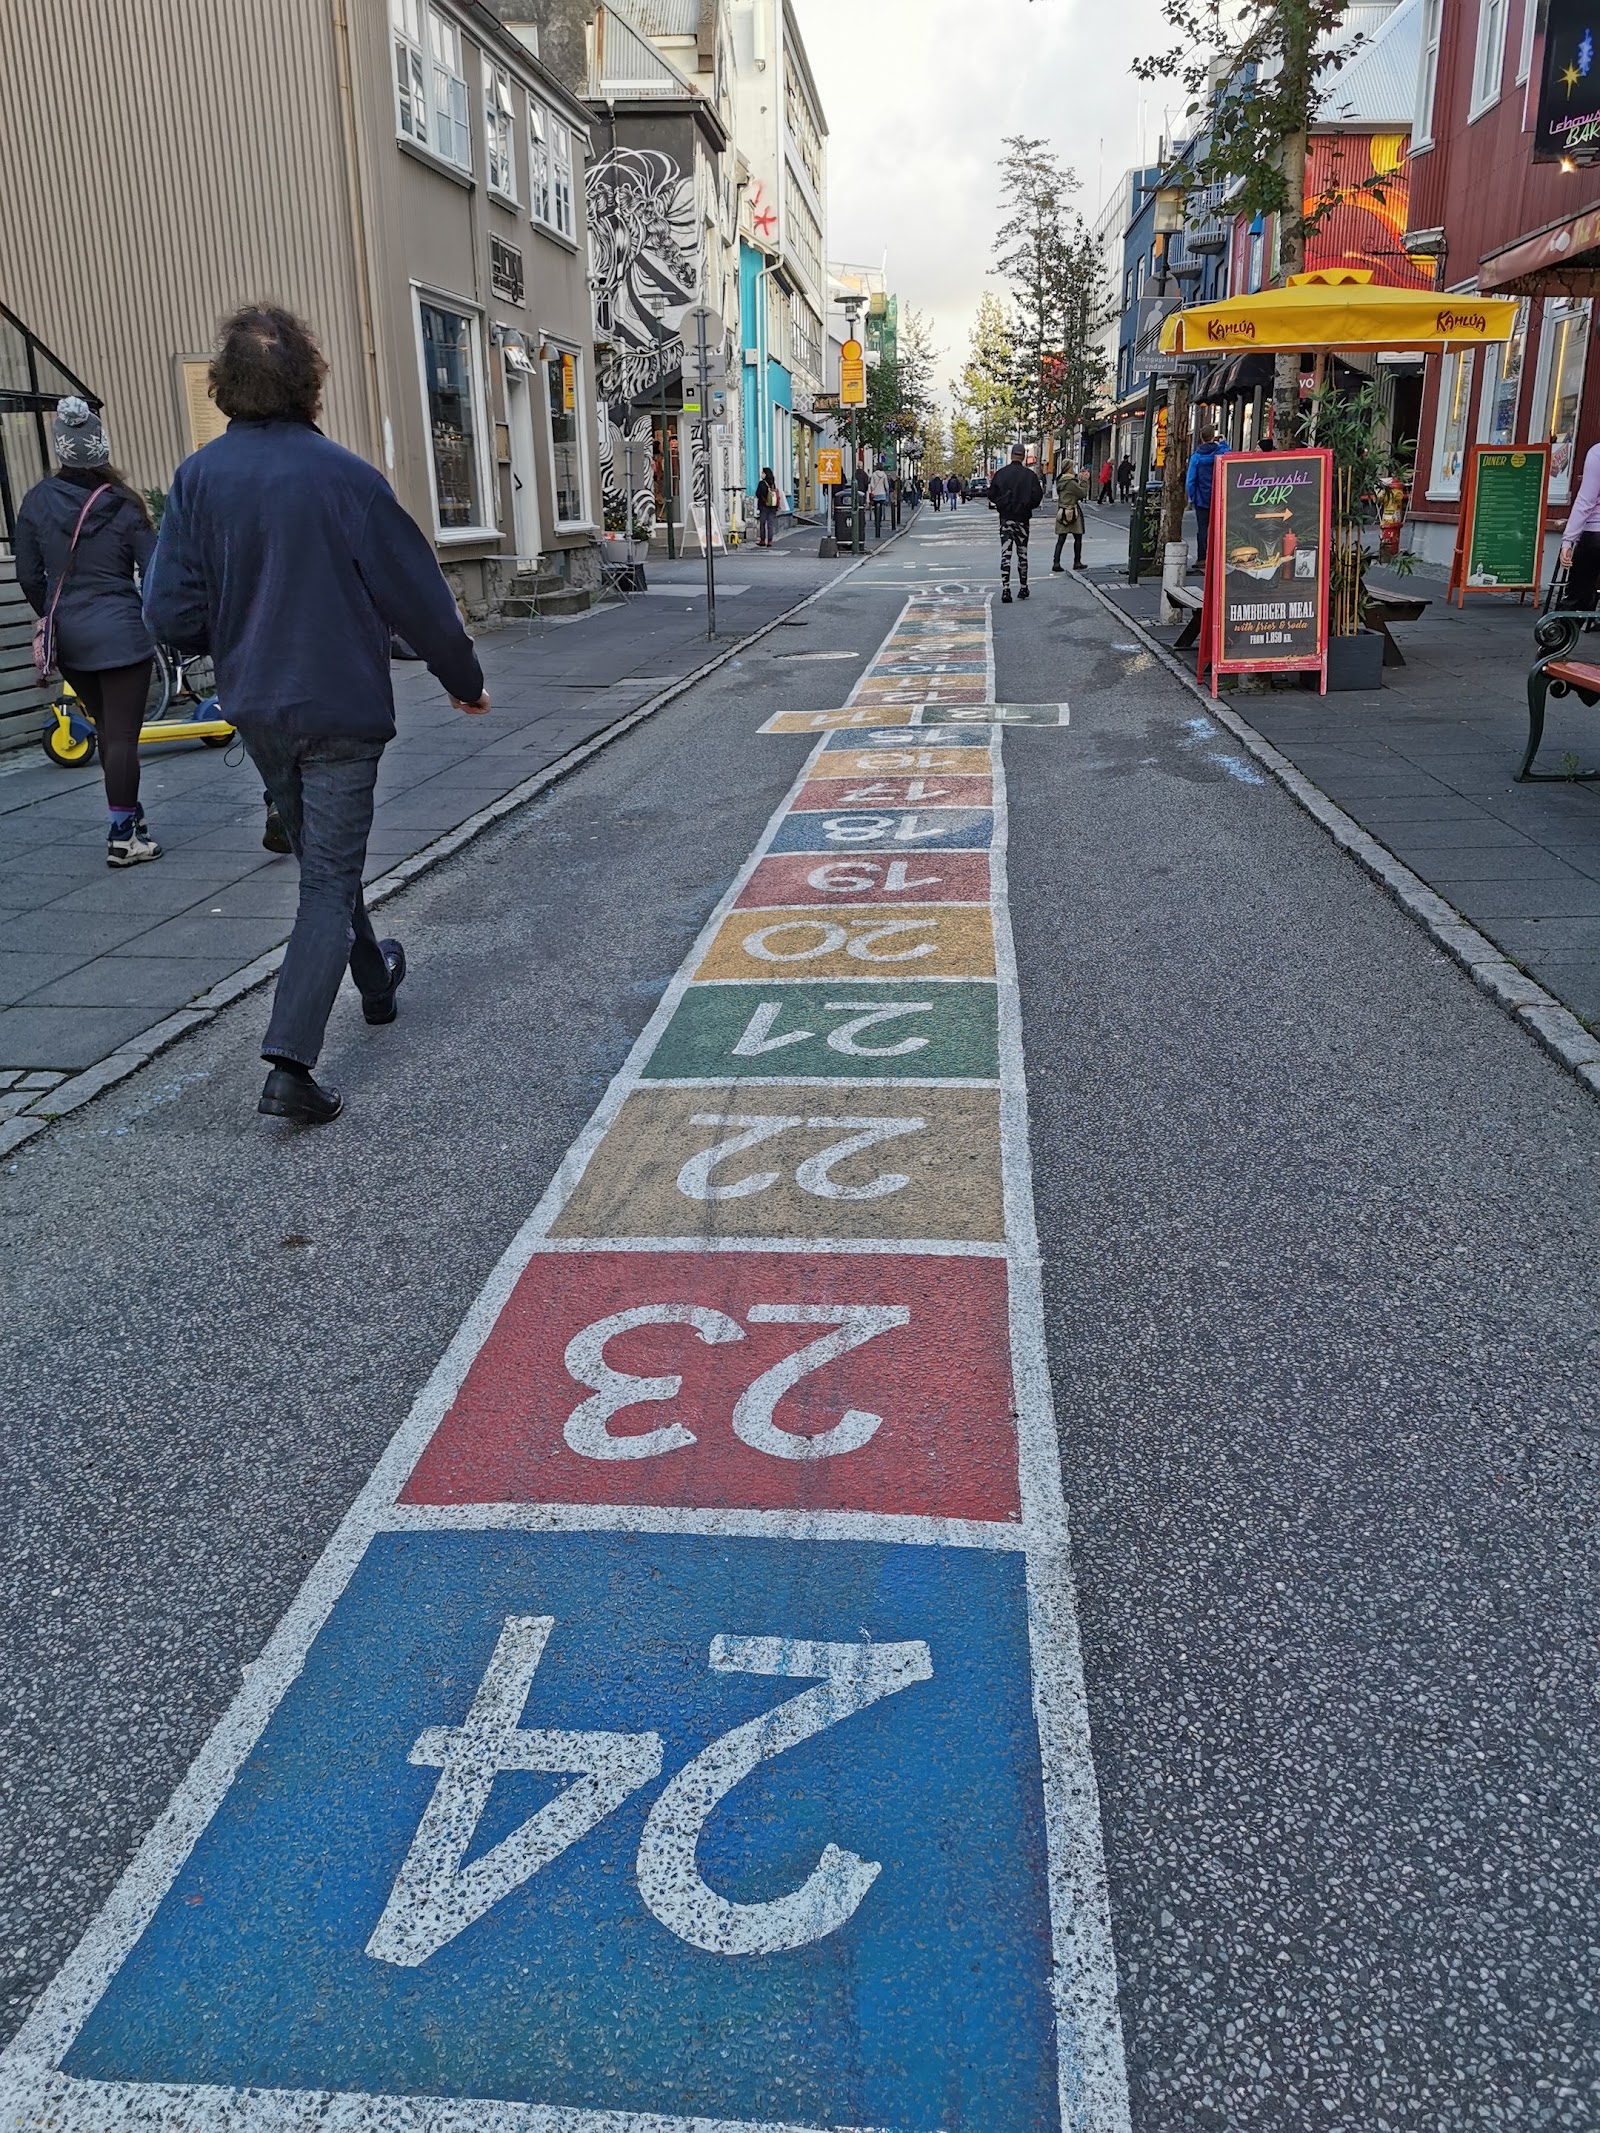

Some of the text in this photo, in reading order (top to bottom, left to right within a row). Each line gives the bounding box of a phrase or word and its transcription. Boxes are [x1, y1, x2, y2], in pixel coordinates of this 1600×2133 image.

[1482, 455, 1507, 467] DINER
[1237, 470, 1313, 488] Lebowski
[1249, 485, 1294, 506] BAR
[1230, 601, 1314, 622] HAMBURGER MEAL
[1234, 620, 1309, 632] with fries & soda
[882, 691, 959, 702] 12
[810, 710, 881, 727] 14
[947, 707, 1032, 719] 13
[868, 729, 960, 743] 15
[837, 781, 950, 801] 17
[822, 816, 946, 841] 18
[807, 861, 943, 893] 19
[742, 919, 938, 961] 20
[731, 1001, 933, 1057] 21
[677, 1114, 926, 1200] 22
[562, 1302, 911, 1461] 23
[364, 1614, 935, 1968] 24
